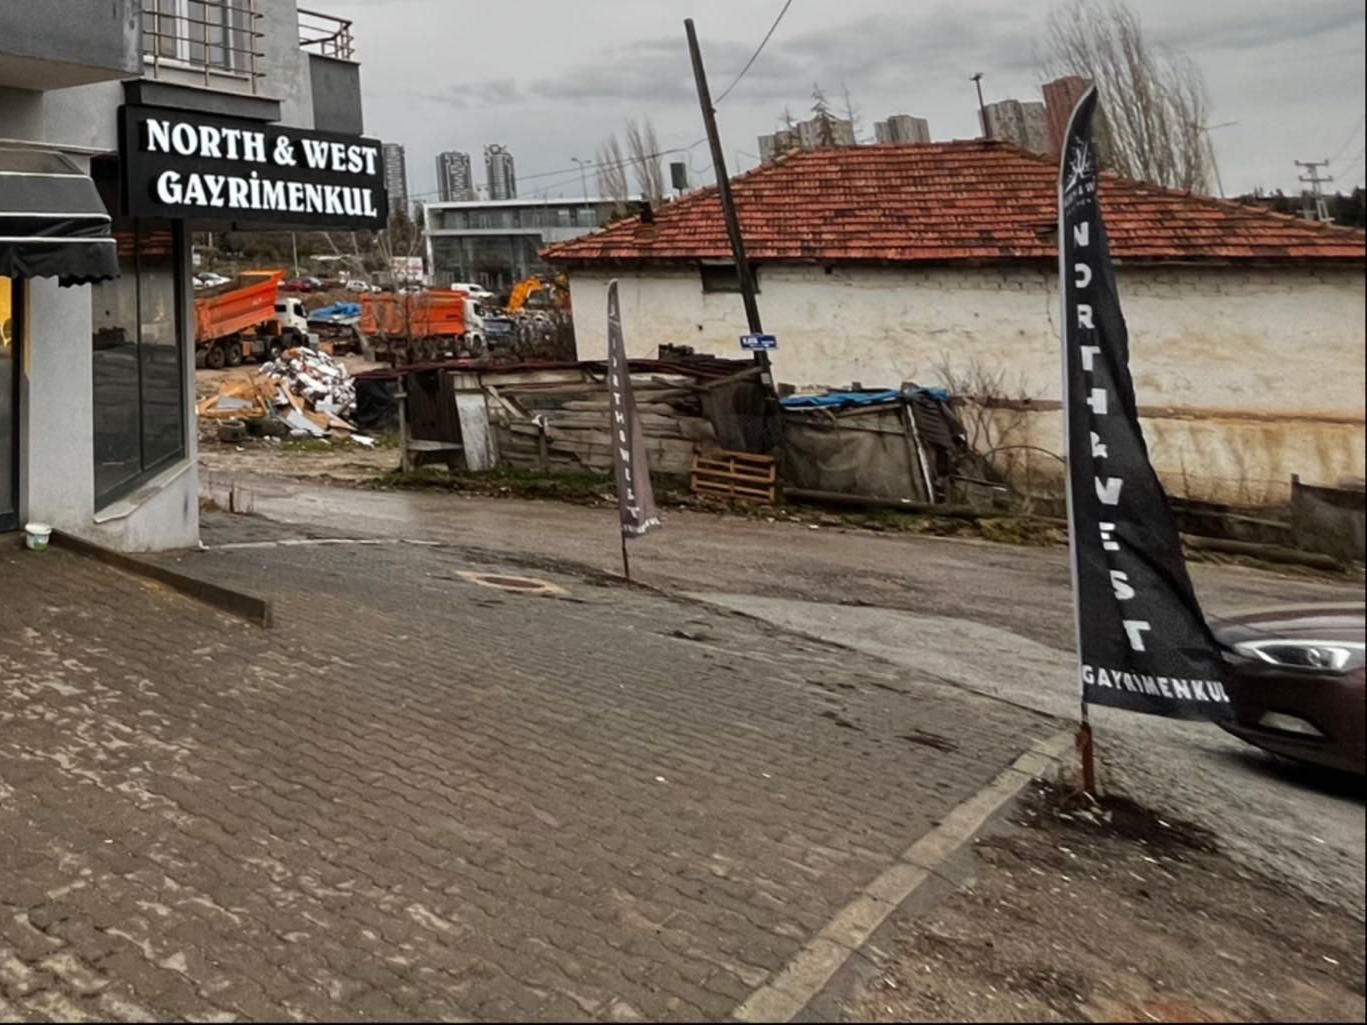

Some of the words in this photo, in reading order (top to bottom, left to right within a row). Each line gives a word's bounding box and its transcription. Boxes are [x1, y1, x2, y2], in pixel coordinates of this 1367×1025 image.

[146, 118, 267, 163] NORTH
[273, 136, 297, 167] &
[301, 139, 378, 175] WEST
[157, 170, 378, 218] GAYRİMENKUL
